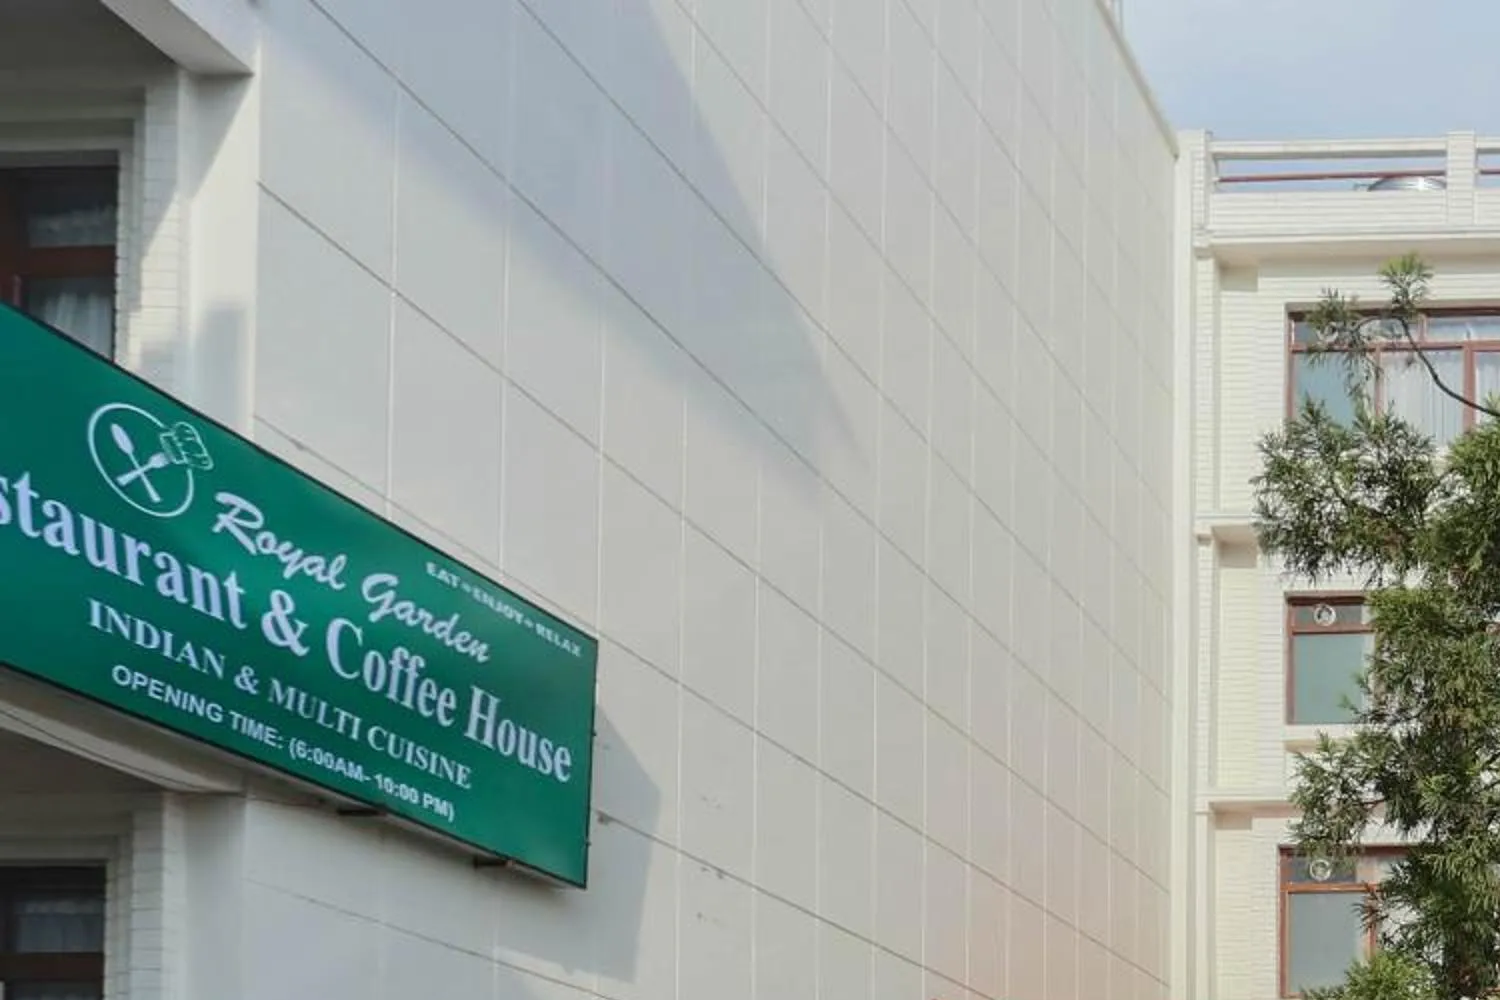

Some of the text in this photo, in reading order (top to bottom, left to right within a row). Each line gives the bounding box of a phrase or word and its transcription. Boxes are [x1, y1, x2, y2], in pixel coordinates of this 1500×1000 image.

[212, 491, 490, 663] Royal Garden
[535, 622, 582, 657] RELAX
[88, 598, 472, 790] INDIAN & MULTI CUISINE
[111, 664, 224, 724] OPENING
[228, 710, 284, 749] TIME:
[374, 773, 420, 805] 10:00
[422, 792, 456, 823] PM)
[261, 588, 310, 656] &
[326, 617, 457, 727] Coffee
[464, 684, 573, 783] House
